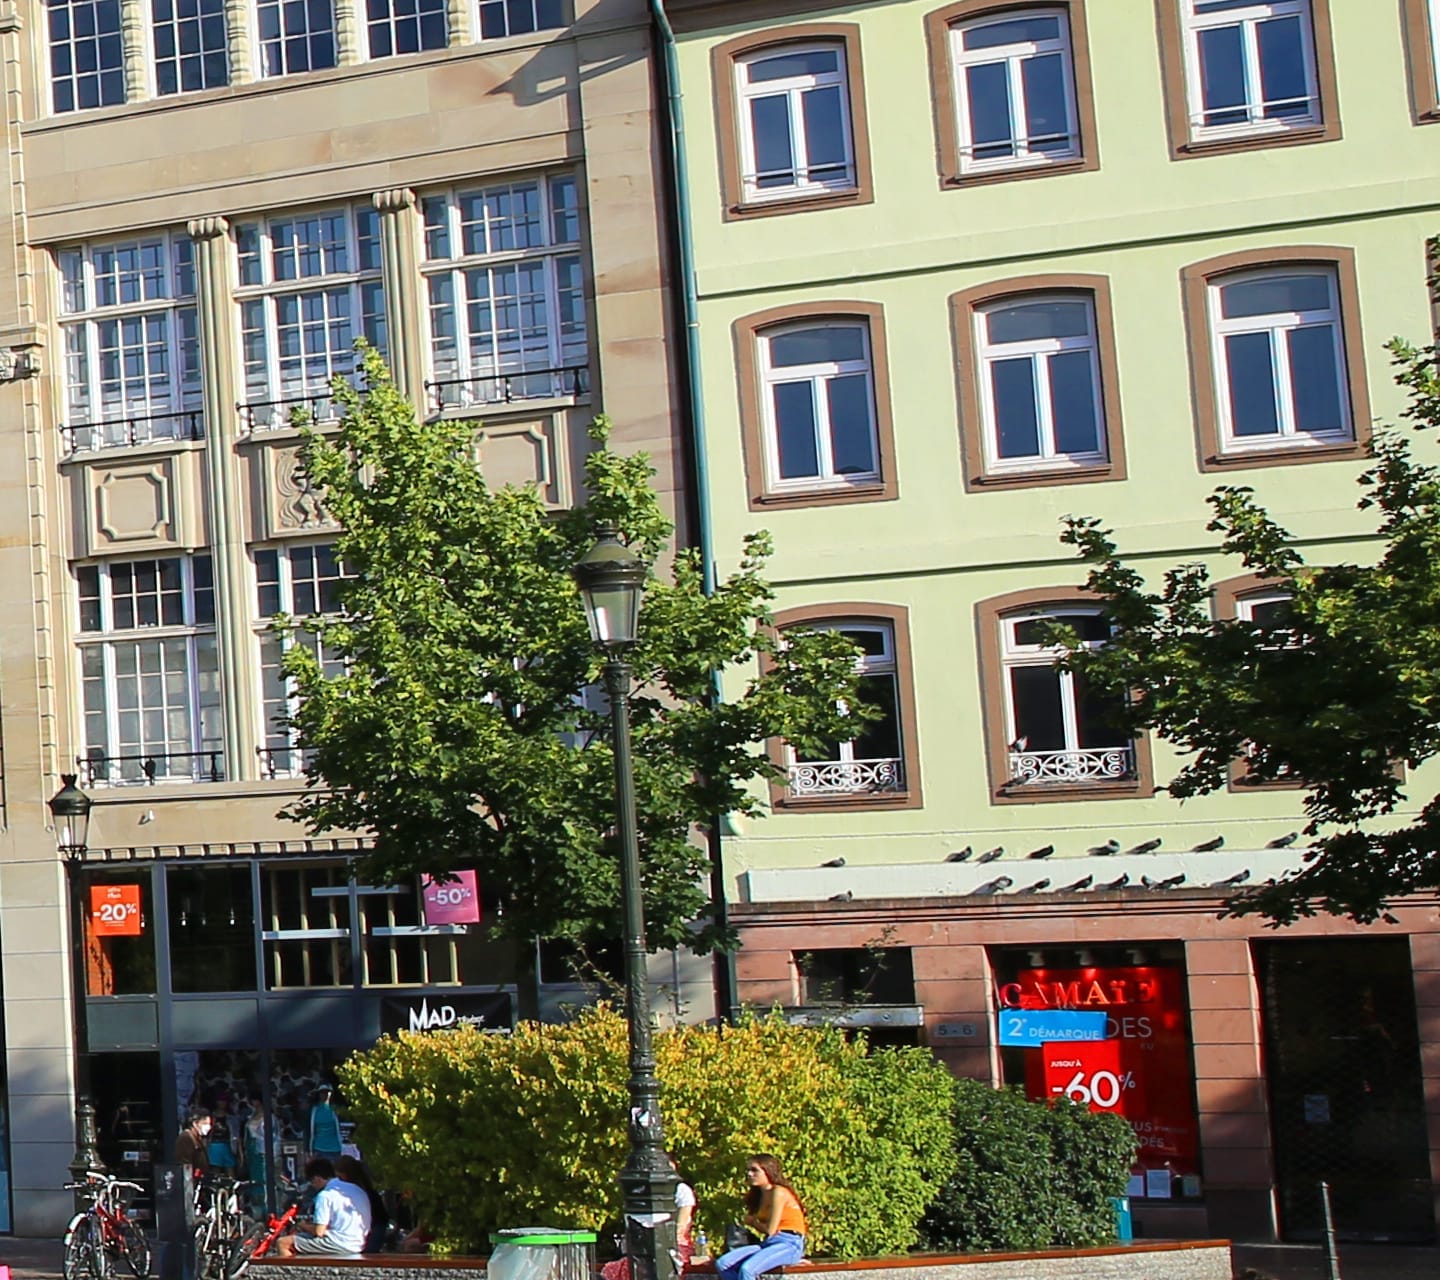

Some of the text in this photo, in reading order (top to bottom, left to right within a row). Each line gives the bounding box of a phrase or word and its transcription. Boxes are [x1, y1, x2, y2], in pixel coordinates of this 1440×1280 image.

[429, 888, 471, 905] -50%
[93, 903, 137, 921] -20%
[1029, 1025, 1101, 1040] DÉMARQUE
[1052, 1071, 1136, 1108] -60%
